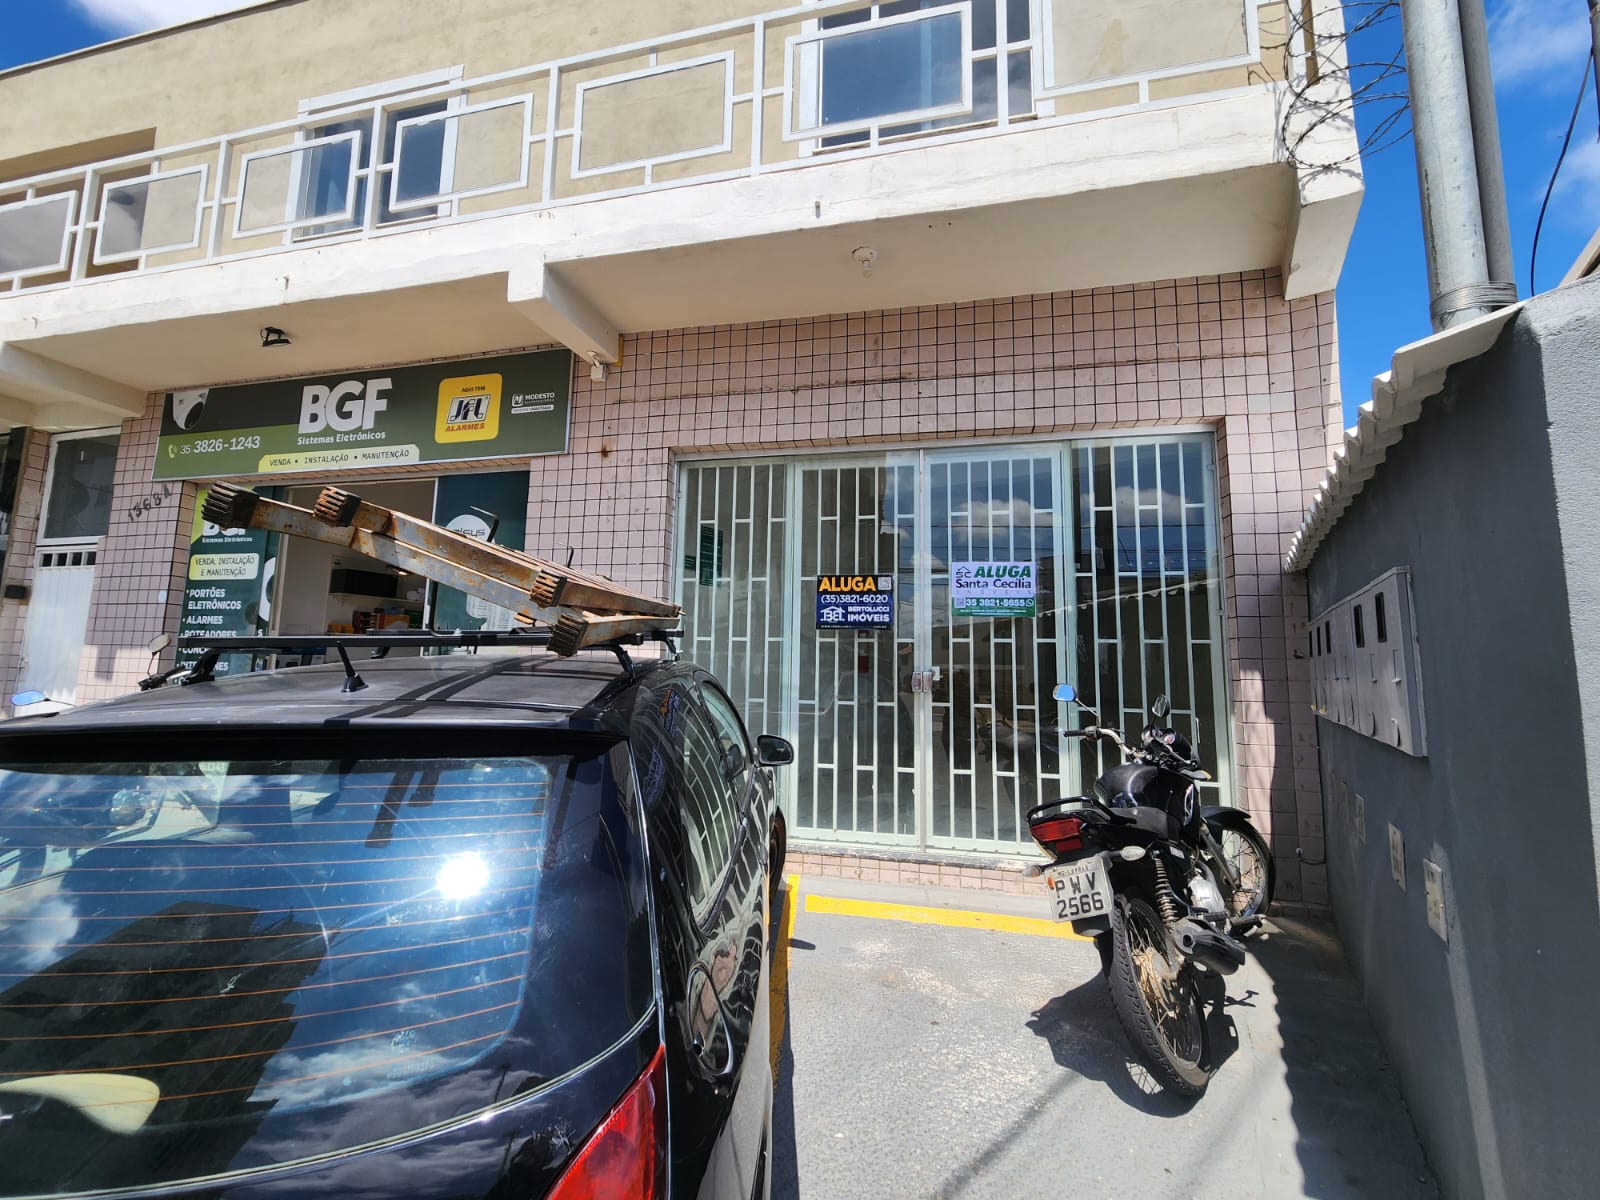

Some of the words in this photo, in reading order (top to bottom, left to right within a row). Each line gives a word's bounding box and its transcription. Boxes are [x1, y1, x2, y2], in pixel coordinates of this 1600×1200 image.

[525, 392, 555, 401] MODESTO
[298, 377, 393, 434] BGF
[445, 422, 485, 433] ALARMES
[297, 435, 334, 445] Sistemas
[335, 431, 386, 442] Eletrônicos
[180, 444, 191, 454] 35
[193, 435, 260, 453] 3826-1243
[269, 458, 291, 467] VENDA
[304, 454, 349, 464] INSTALAÇÃO
[362, 449, 410, 459] MANUTENÇÃO
[218, 555, 255, 567] INSTALAÇÃO
[200, 568, 205, 576] E
[206, 566, 247, 577] MANUTENÇÃO
[974, 565, 1032, 578] ALUGA
[818, 576, 877, 592] ALUGA
[955, 578, 989, 589] Santa
[993, 578, 1032, 589] Cecília
[189, 586, 226, 598] PORTÕES
[187, 598, 242, 610] ELETRÔNICOS
[820, 594, 889, 604] (35)3821-6020
[966, 598, 977, 606] 35
[186, 615, 224, 625] ALARMES
[847, 611, 890, 622] IMÓVEIS
[1056, 891, 1104, 919] 2566
